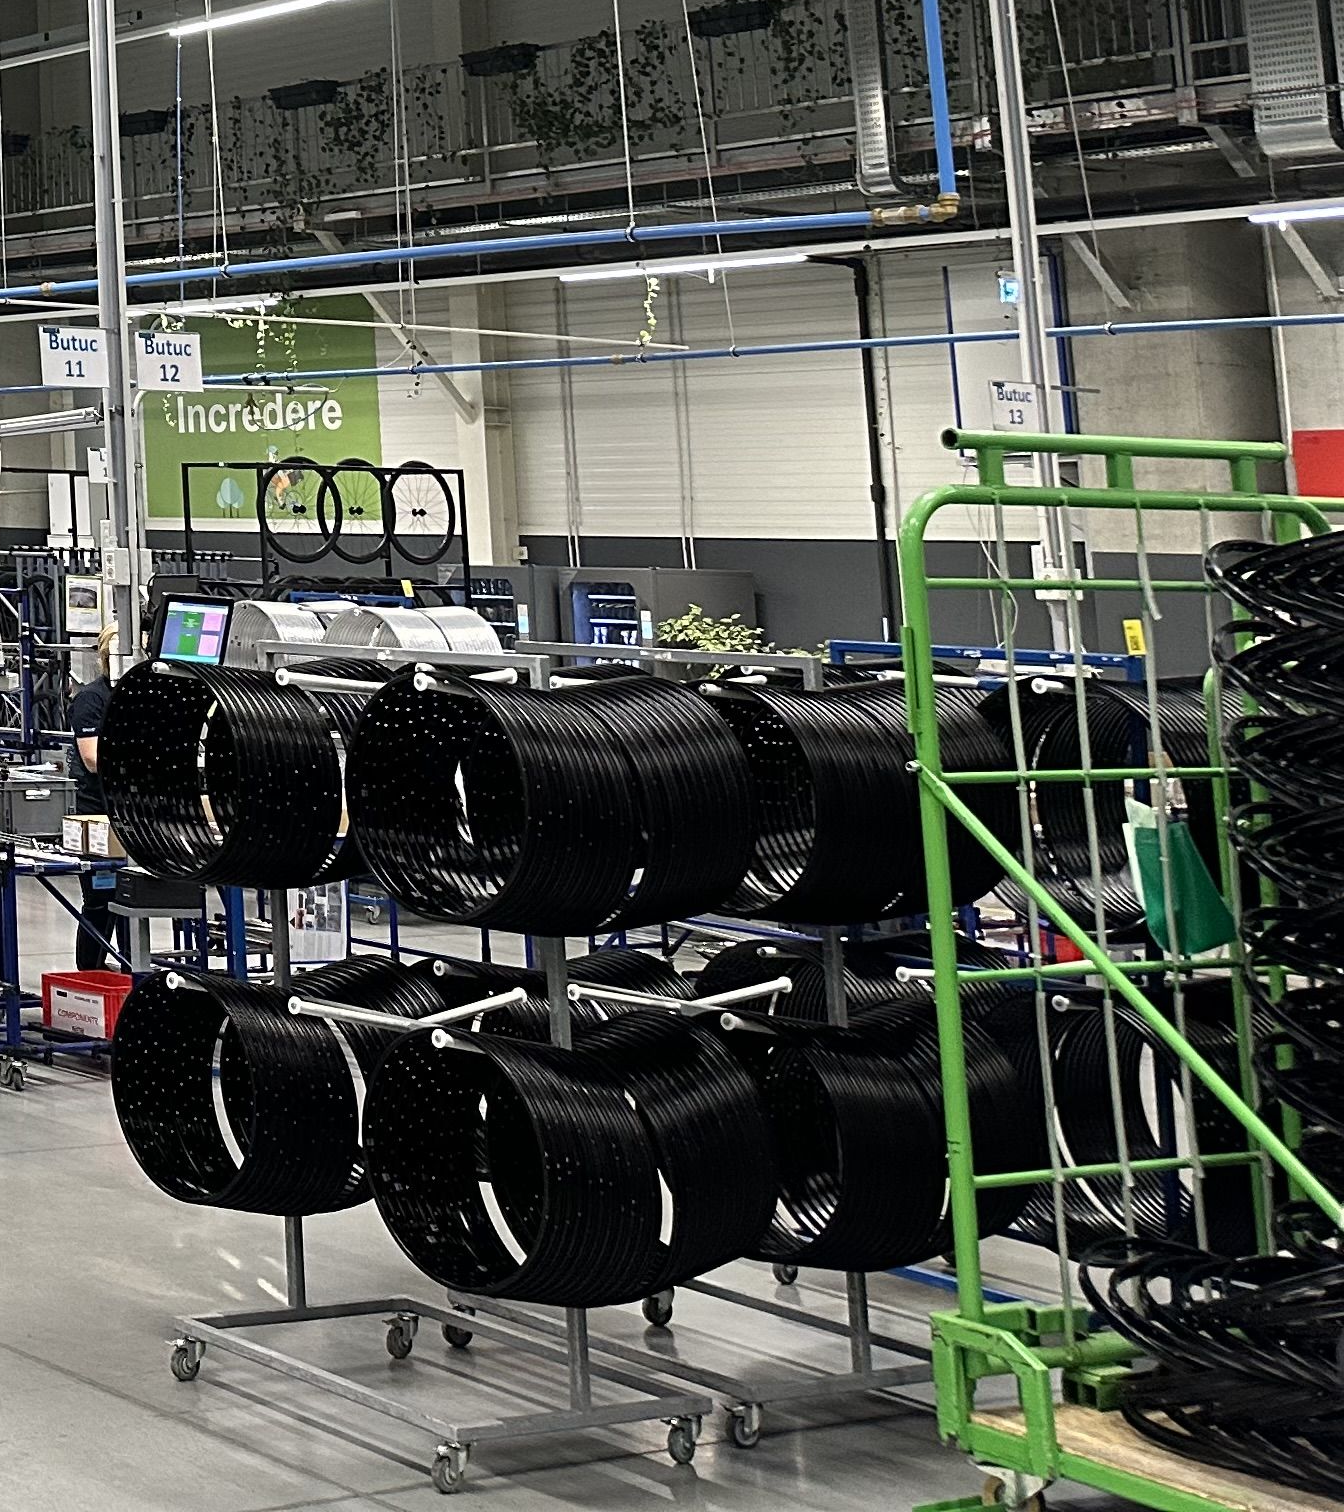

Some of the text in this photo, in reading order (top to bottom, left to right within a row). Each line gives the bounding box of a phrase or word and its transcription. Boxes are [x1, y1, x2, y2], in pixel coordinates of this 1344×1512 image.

[48, 332, 98, 352] Butuc
[145, 337, 191, 357] Butuc
[64, 360, 85, 378] 11
[159, 364, 180, 383] 12
[996, 387, 1032, 403] Butuc
[177, 392, 343, 433] Incredere
[1009, 409, 1024, 424] 13
